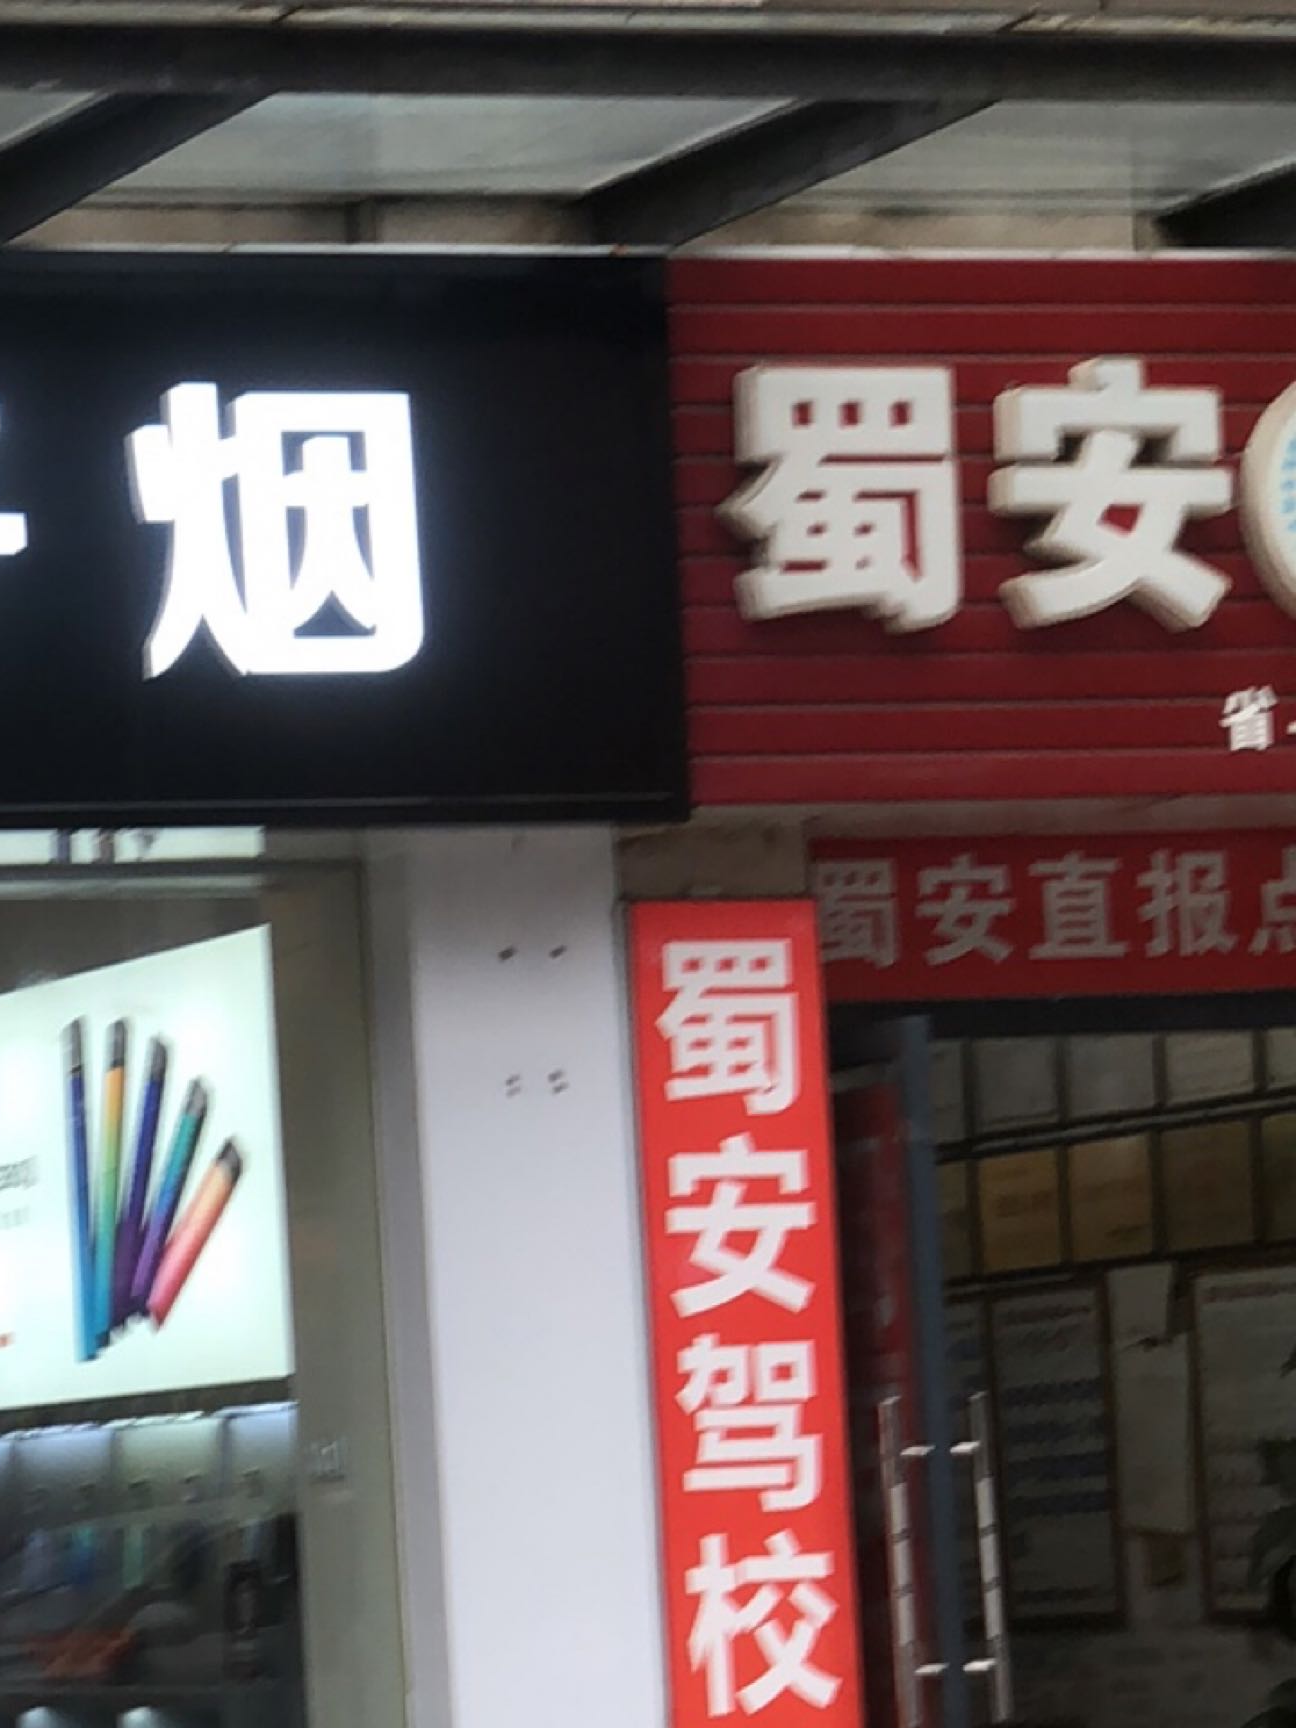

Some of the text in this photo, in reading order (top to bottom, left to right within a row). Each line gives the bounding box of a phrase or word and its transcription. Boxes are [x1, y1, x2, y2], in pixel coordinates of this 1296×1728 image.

[715, 354, 1234, 633] 蜀安
[654, 936, 844, 1720] 蜀安驾校
